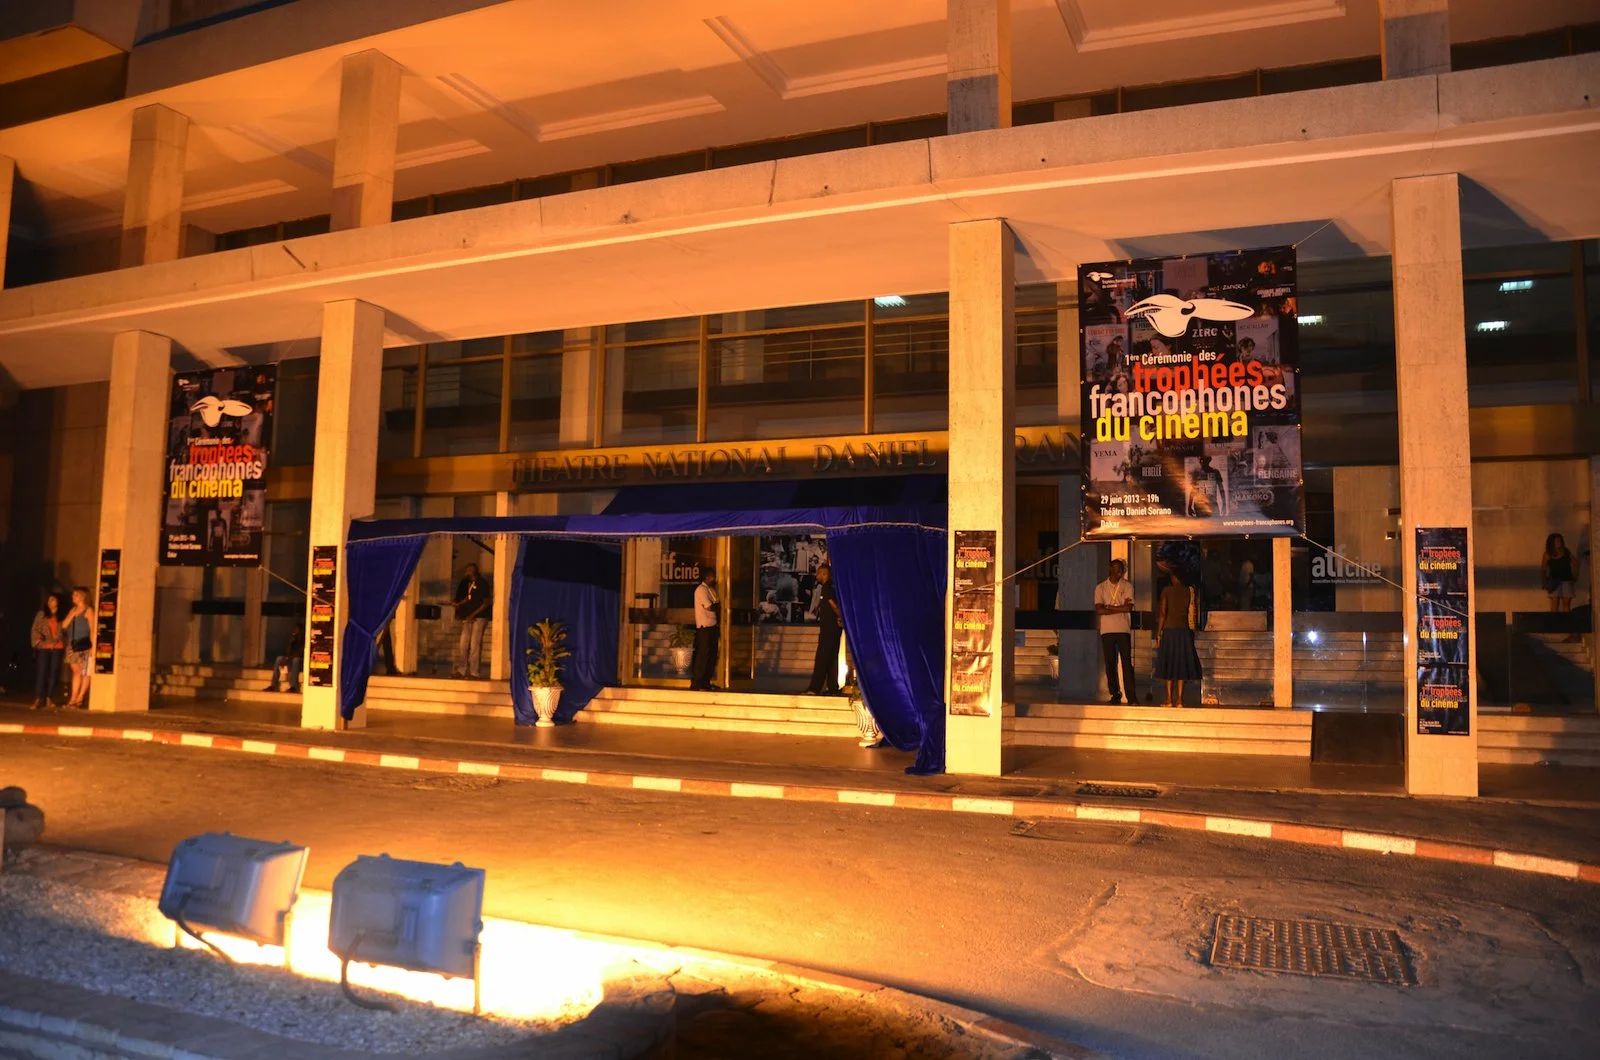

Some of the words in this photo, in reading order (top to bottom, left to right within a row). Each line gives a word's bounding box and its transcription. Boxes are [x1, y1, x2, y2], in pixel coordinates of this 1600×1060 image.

[1142, 351, 1192, 365] Cérémonie
[1199, 350, 1217, 362] des
[1132, 353, 1264, 400] trophées
[1089, 379, 1287, 424] francophones
[1096, 407, 1131, 442] du
[1139, 402, 1249, 441] cinéma
[189, 440, 254, 466] trophées
[641, 446, 790, 478] NATIONAL
[811, 439, 938, 473] DANIEL
[1094, 450, 1118, 458] YEMA
[170, 459, 263, 482] francophones
[171, 475, 187, 498] du
[1100, 495, 1109, 504] 29
[1109, 495, 1122, 505] juin
[1124, 494, 1140, 504] 2013
[1147, 494, 1159, 503] 19h
[1100, 507, 1124, 516] Théâtre
[1126, 507, 1147, 516] Daniel
[1147, 507, 1171, 515] Sorano
[1100, 519, 1120, 528] Dakar
[1419, 560, 1429, 570] du
[1430, 560, 1457, 570] cinéma
[1420, 629, 1429, 639] du
[1420, 698, 1430, 708] du
[1431, 698, 1458, 708] cinéma
